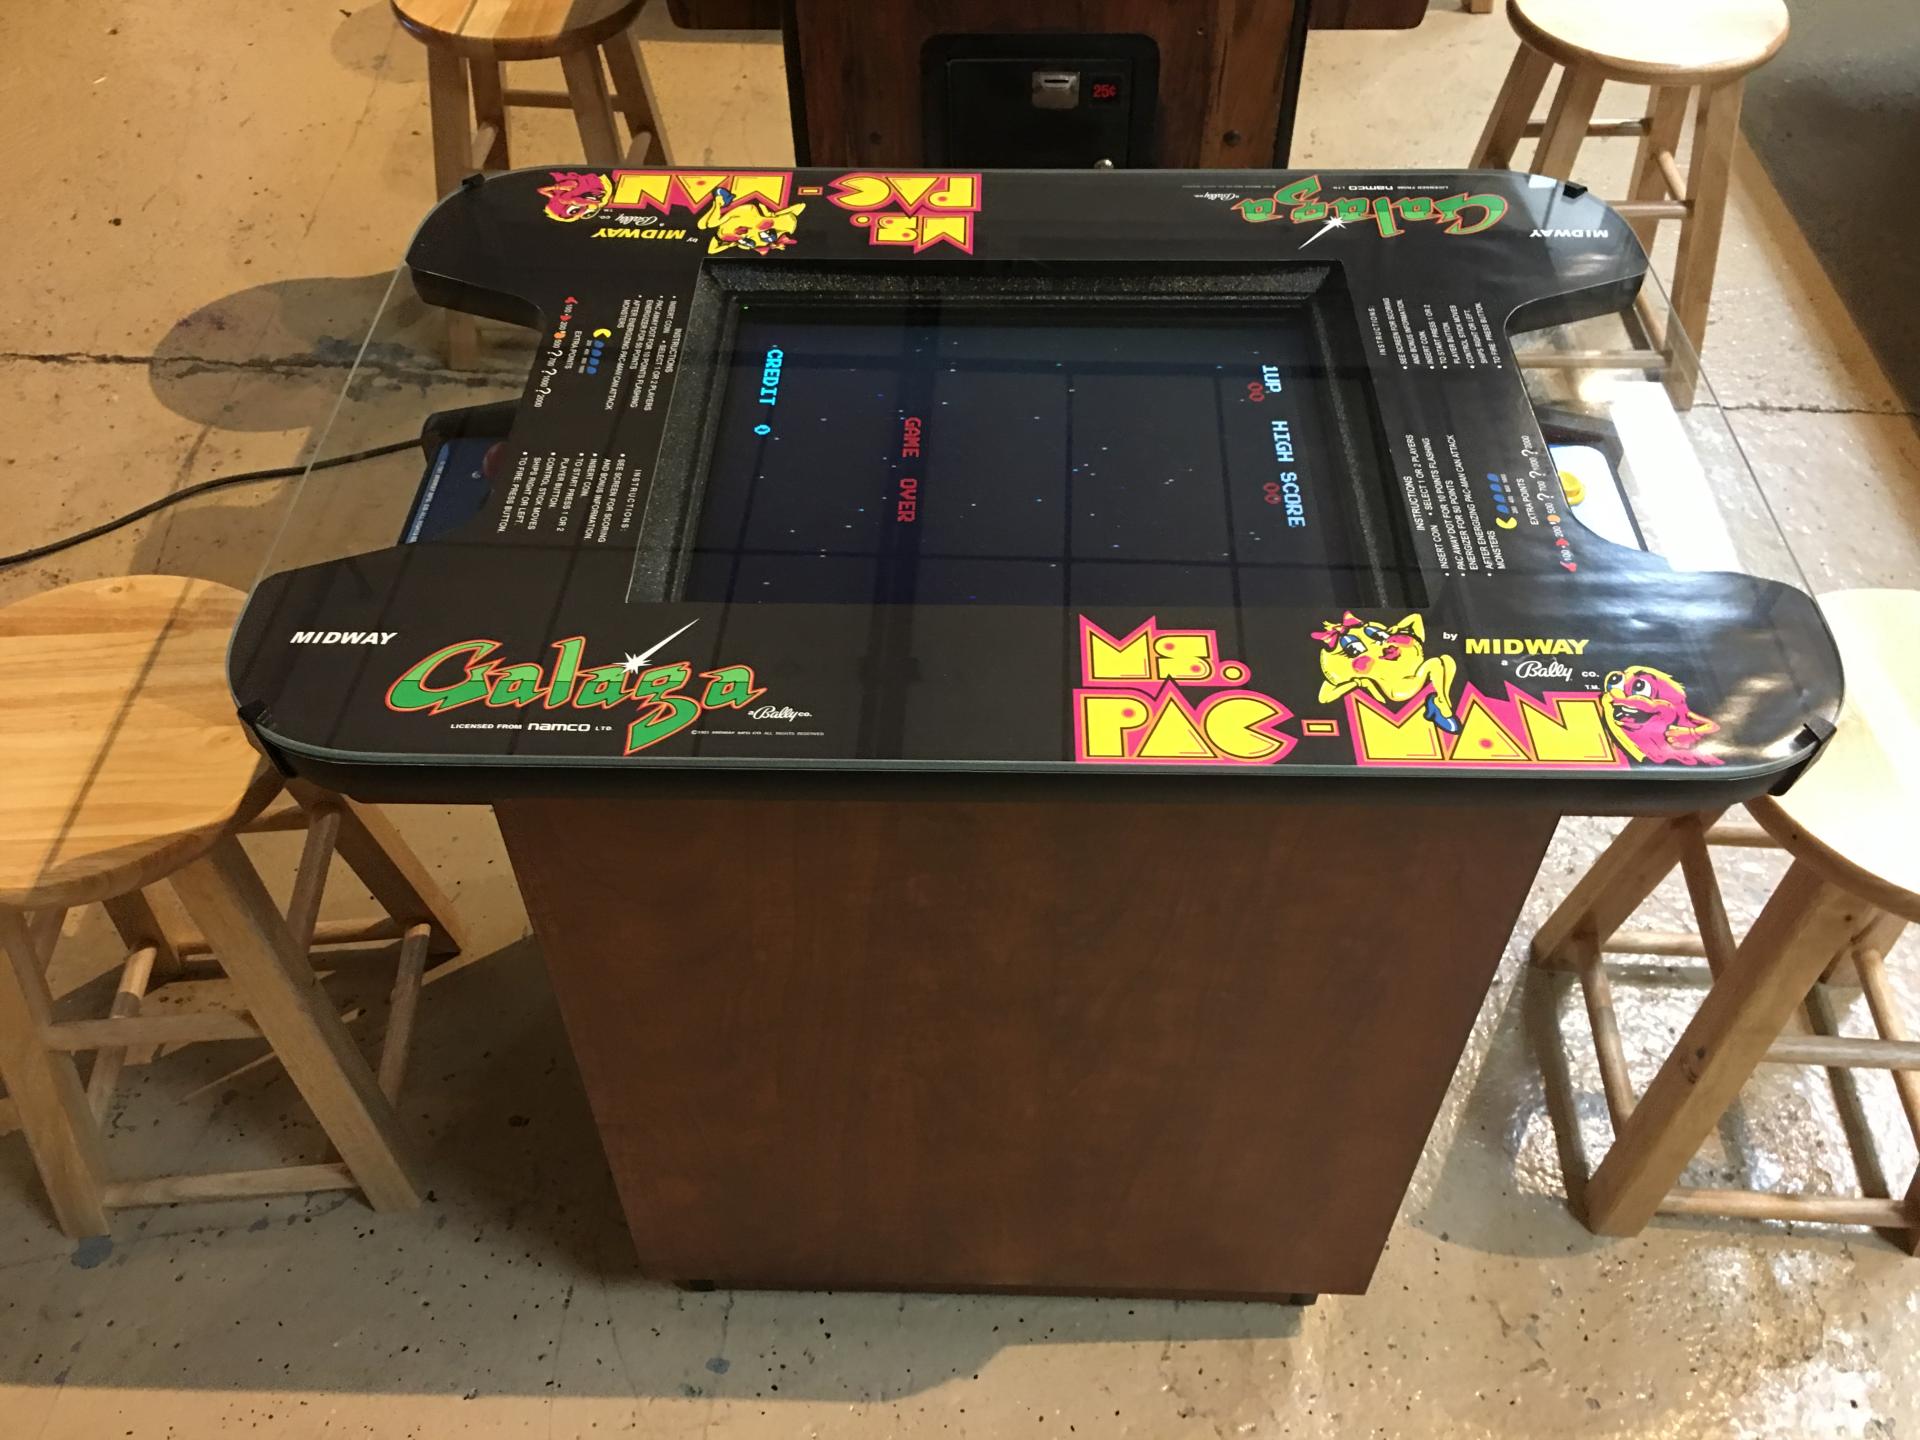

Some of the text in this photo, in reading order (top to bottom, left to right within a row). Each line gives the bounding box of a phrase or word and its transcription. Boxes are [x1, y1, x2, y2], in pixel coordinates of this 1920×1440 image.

[1092, 83, 1117, 99] 25¢
[1231, 175, 1509, 238] Galaga
[615, 213, 658, 226] Bally
[590, 227, 687, 239] MIDWAY
[1529, 229, 1609, 239] MIDWAY
[616, 299, 630, 328] MONSTERS
[639, 299, 653, 328] ENERGIZER
[653, 299, 663, 310] PAC
[650, 311, 660, 325] AWAY
[662, 300, 676, 333] INSERT COIN
[636, 330, 646, 341] FOR
[647, 326, 657, 337] DOT
[564, 330, 582, 369] EXTRA POINTS
[644, 338, 654, 349] FOR
[664, 328, 682, 372] INSTRUCTIONS
[604, 299, 641, 410] AFTER ENERGIZING PAC-MAN CAN ATTACK
[629, 349, 641, 369] POINTS
[654, 344, 666, 365] SELECT
[637, 358, 649, 378] POINTS
[650, 370, 660, 379] OR
[629, 379, 643, 407] FLASHING
[643, 385, 657, 410] PLAYERS
[754, 349, 783, 435] CREDIT 0
[1262, 364, 1306, 528] 1UP HIGH SCORE
[1405, 434, 1420, 462] PLAYERS
[1421, 437, 1437, 468] FLASHING
[517, 457, 528, 465] TO
[528, 457, 542, 475] SHIPS
[555, 457, 570, 481] PLAYER
[574, 458, 584, 466] TO
[584, 458, 598, 480] INSERT
[600, 458, 612, 471] AND
[897, 416, 922, 522] GAME OVER
[568, 468, 581, 487] START
[594, 472, 608, 492] BONUS
[1414, 468, 1424, 478] OR
[1430, 469, 1444, 493] POINTS
[505, 483, 519, 504] PRESS
[523, 476, 536, 494] RIGHT
[526, 457, 556, 529] CONTROL STICK MOVES
[519, 496, 530, 506] OR
[562, 488, 575, 509] PRESS
[596, 458, 626, 542] SEE SCREEN FOR SCORING
[1402, 475, 1425, 530] INSTRUCTIONS
[1418, 484, 1433, 509] SELECT
[1445, 434, 1494, 569] AFTER ENERGIZING PAC-MAN CAN ATTACK
[1515, 478, 1539, 524] EXTRA POINTS
[557, 516, 568, 526] OR
[1439, 504, 1451, 517] FOR
[1444, 479, 1478, 569] ENERGIZER FOR 50 POINTS
[1444, 519, 1455, 533] DOT
[1429, 524, 1449, 568] INSERT COIN
[1448, 534, 1462, 554] AWAY
[1486, 530, 1506, 568] MONSTERS
[1454, 555, 1466, 569] PAC
[290, 631, 398, 646] MIDWAY
[1442, 632, 1589, 655] by MIDWAY
[1515, 660, 1573, 682] Bally
[385, 636, 769, 756] Galaga
[752, 705, 798, 722] Bally
